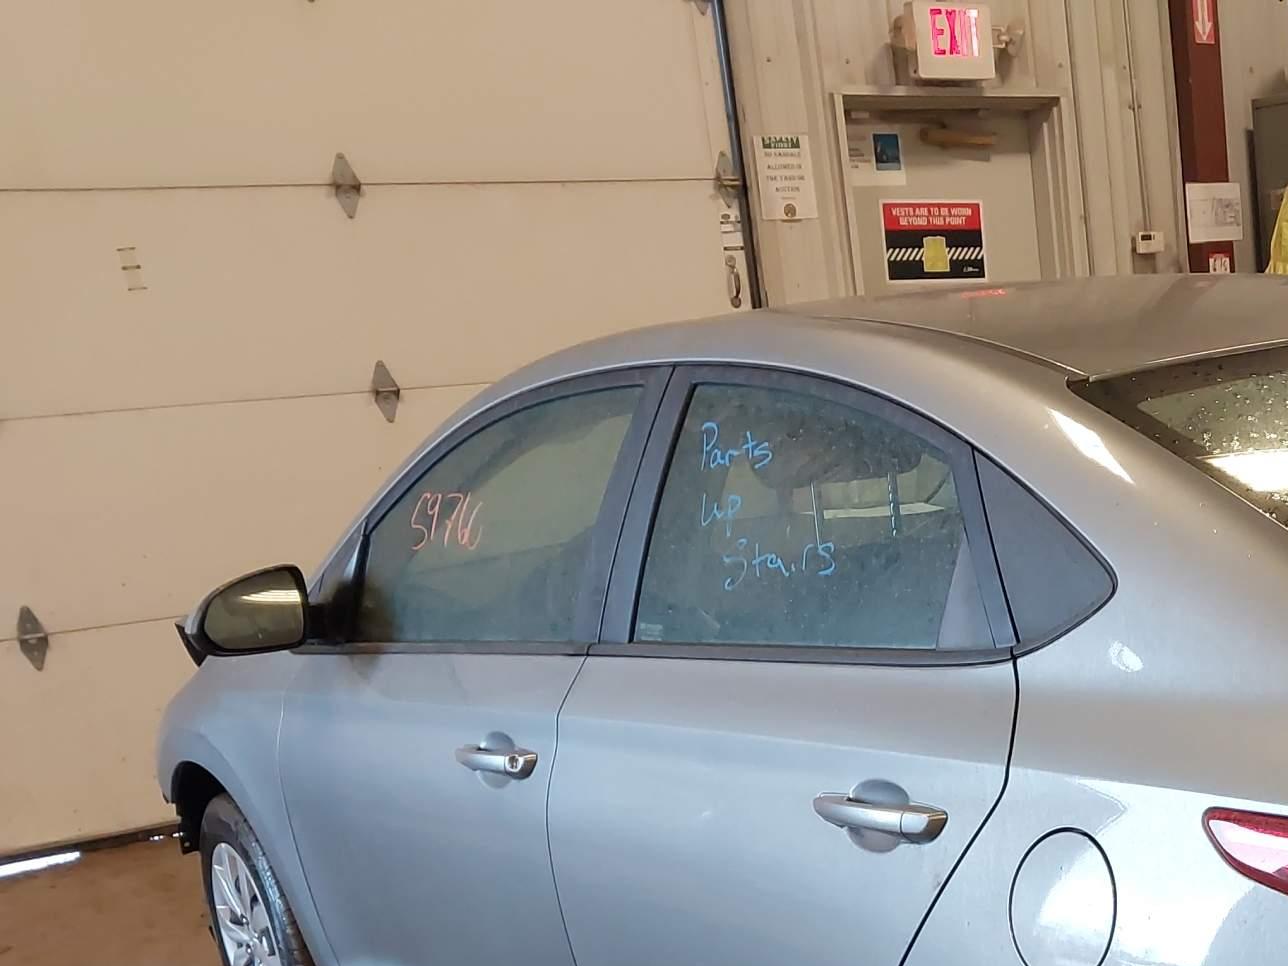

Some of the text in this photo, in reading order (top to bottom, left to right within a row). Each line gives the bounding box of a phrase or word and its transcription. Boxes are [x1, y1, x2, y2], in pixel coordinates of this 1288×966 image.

[929, 8, 979, 56] EXIT
[891, 207, 972, 217] VESTS ARE TO BE WORN
[899, 216, 966, 226] BEYOND THIS POINT
[700, 421, 773, 471] Parts
